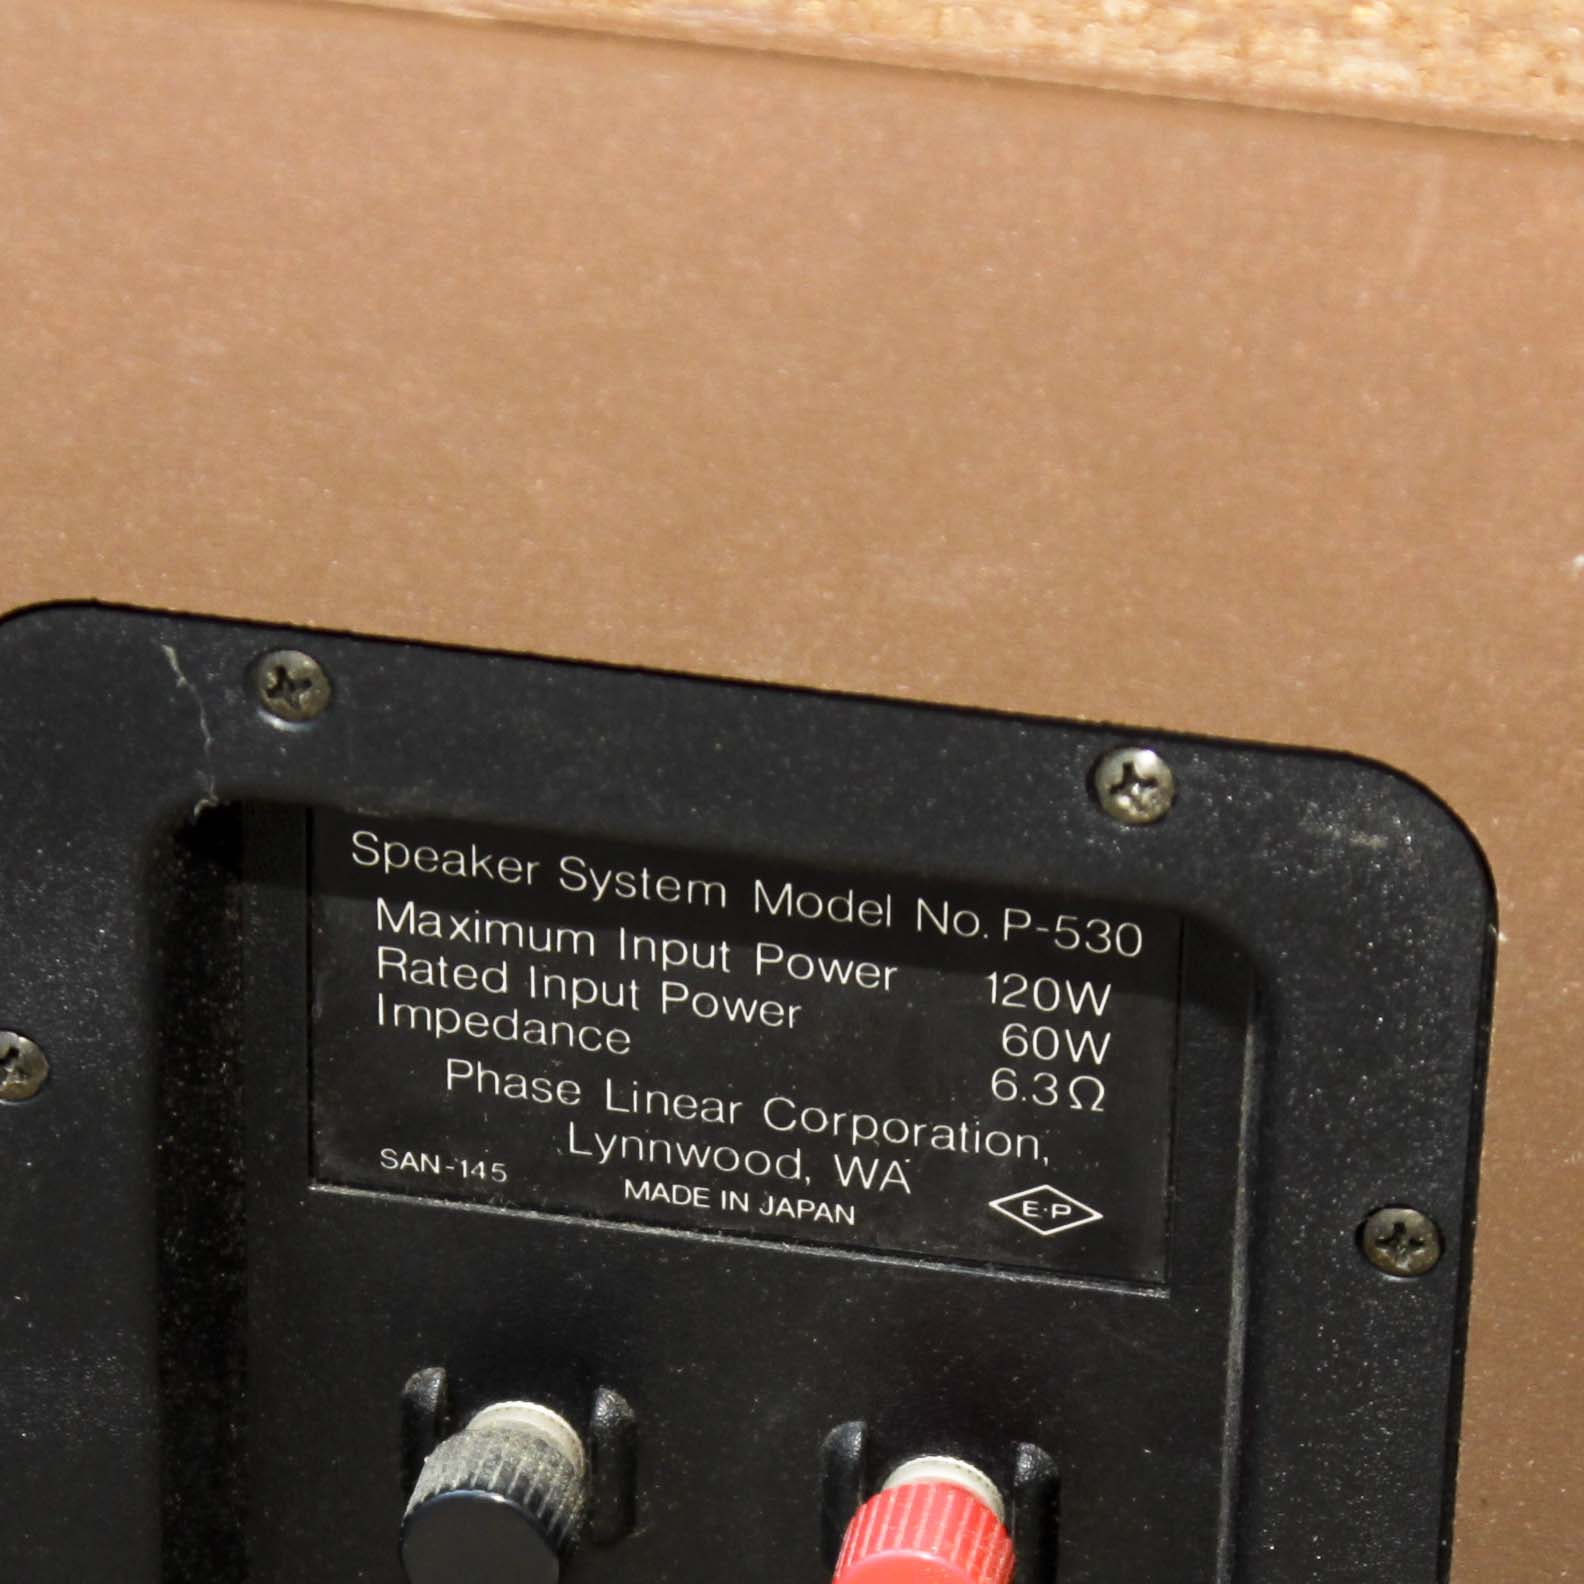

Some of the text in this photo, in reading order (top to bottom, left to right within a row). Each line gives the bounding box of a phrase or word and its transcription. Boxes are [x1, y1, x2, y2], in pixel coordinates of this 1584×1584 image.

[351, 828, 1143, 955] Speaker System Model No. P-530
[375, 895, 1112, 1014] Maximum Input Power 120W
[377, 944, 1112, 1062] Rated Input Power 60W
[377, 992, 632, 1054] Impedance
[445, 1056, 1050, 1162] Phase Linear Corporation,
[379, 1146, 508, 1181] SAN-145
[568, 1120, 912, 1192] Lynnwood, WA
[623, 1178, 856, 1223] MADE IN JAPAN
